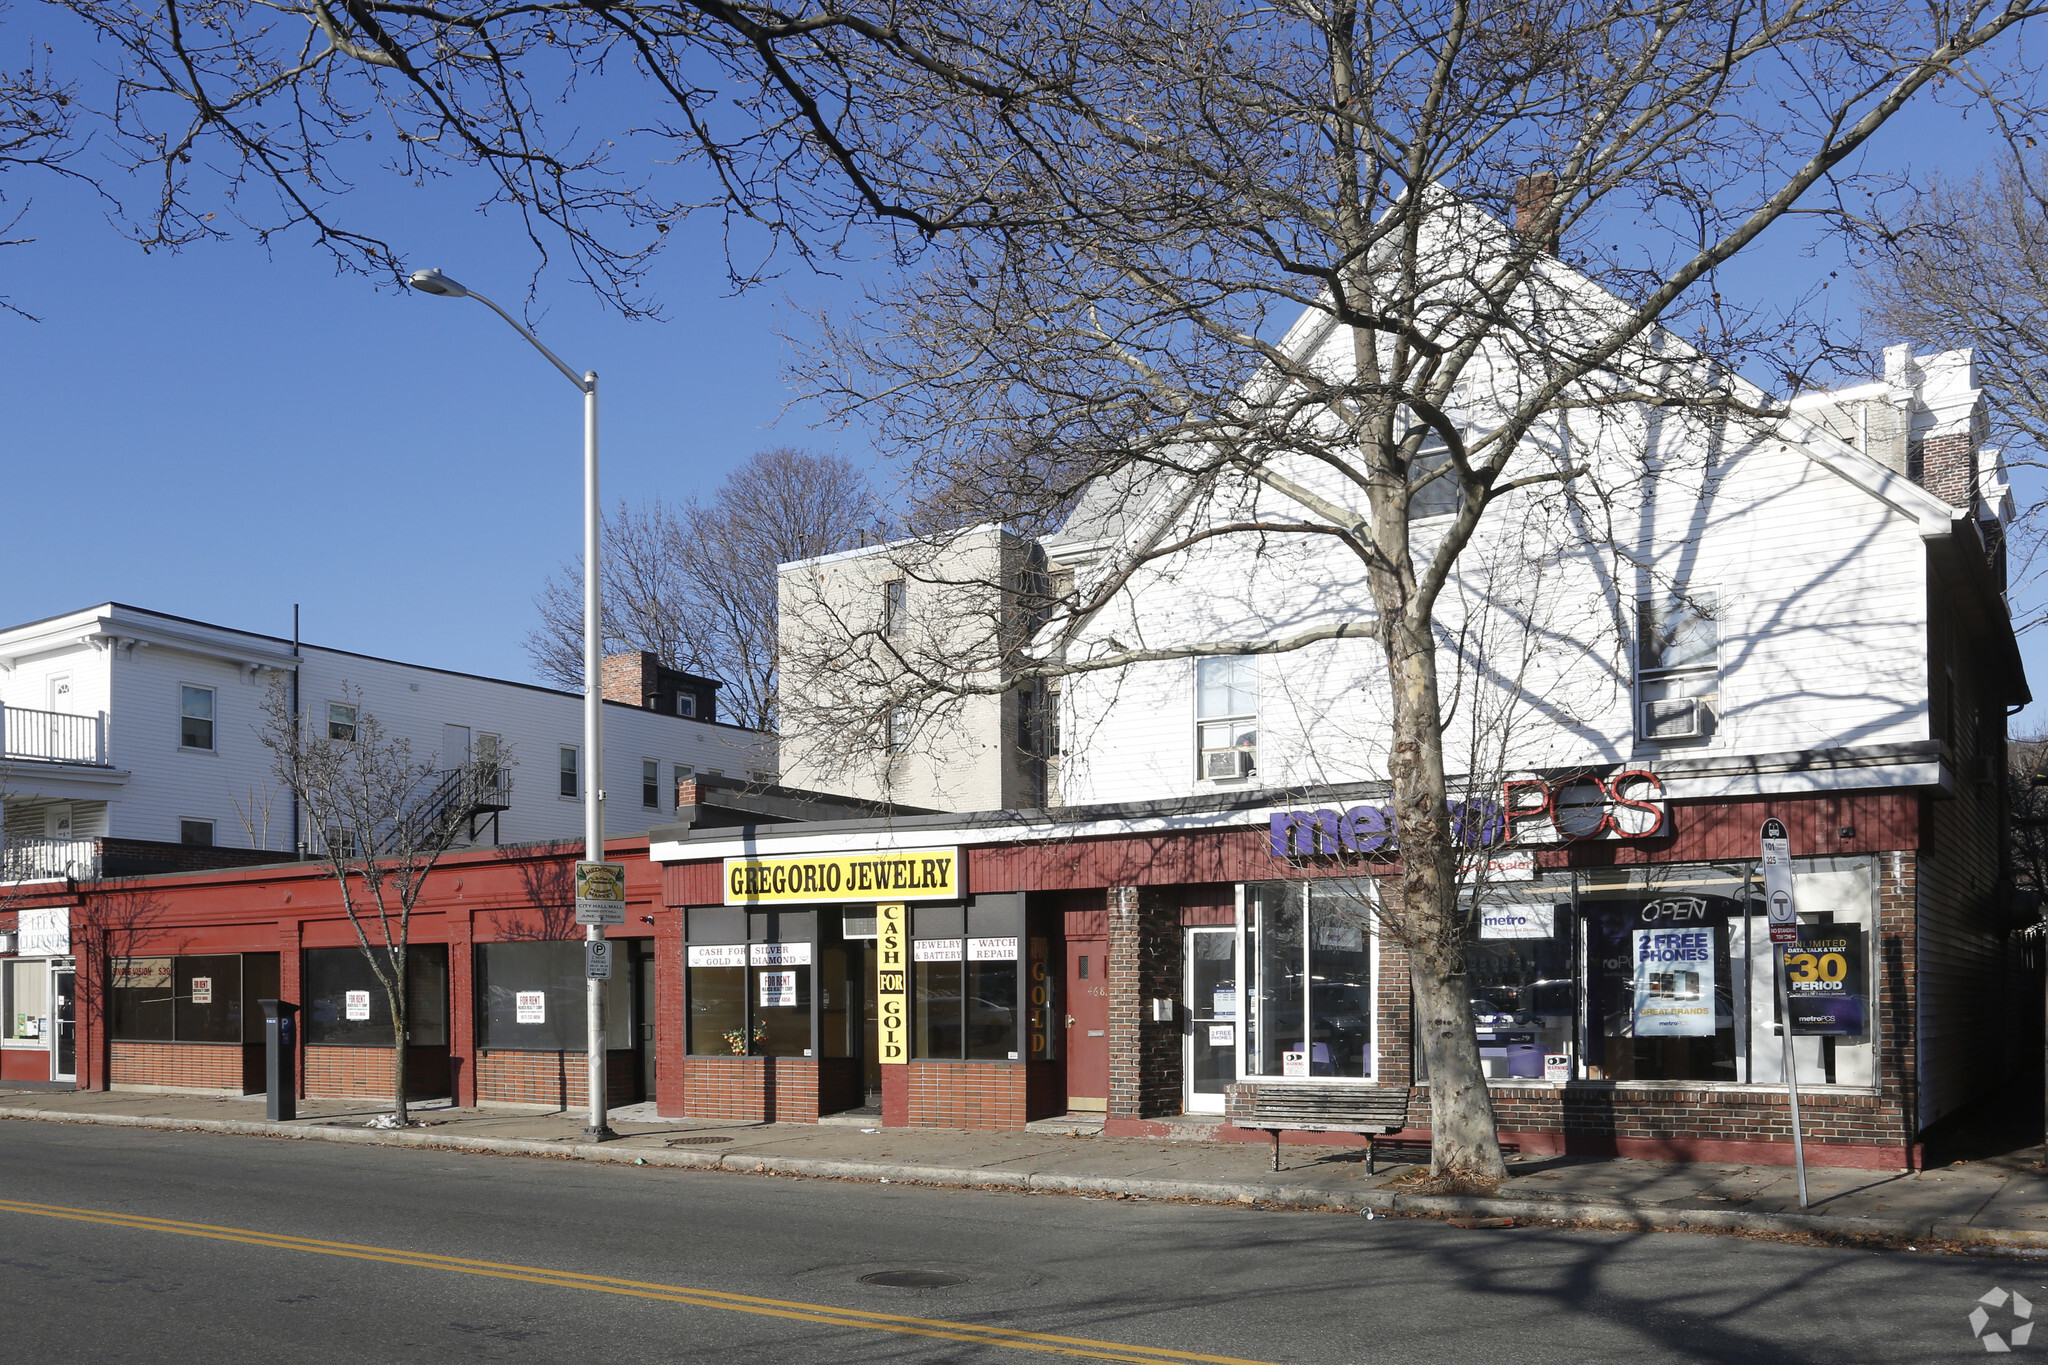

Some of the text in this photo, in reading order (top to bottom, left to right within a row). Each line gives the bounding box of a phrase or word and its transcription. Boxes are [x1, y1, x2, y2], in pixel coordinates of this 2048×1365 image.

[1488, 860, 1532, 871] Dealer
[586, 867, 616, 877] MEDFORD
[731, 858, 951, 895] GREGORIO JEWELRY
[589, 891, 613, 899] MARKET
[1641, 897, 1707, 921] OPEN
[1773, 898, 1788, 916] T
[915, 940, 961, 950] JEWELRY
[979, 938, 1017, 948] WATCH
[1639, 933, 1708, 950] 2 FREE
[1788, 939, 1847, 948] UNLIMITED
[699, 946, 789, 956] CASH FOR SILVER
[923, 950, 963, 960] BATTERY
[976, 949, 1015, 959] REPAIR
[1639, 948, 1709, 962] PHONES
[706, 958, 731, 966] GOLD
[752, 956, 796, 965] DIAMOND
[113, 967, 132, 976] SINGLE
[132, 967, 152, 976] VISION
[1784, 953, 1847, 982] $30
[764, 975, 790, 986] FOR RENT
[879, 907, 903, 1058] CASH FOR GOLD
[1792, 981, 1843, 991] PERIOD
[520, 996, 541, 1005] FOR RENT
[1032, 962, 1046, 1052] GOLD
[1640, 1008, 1669, 1016] GREAT
